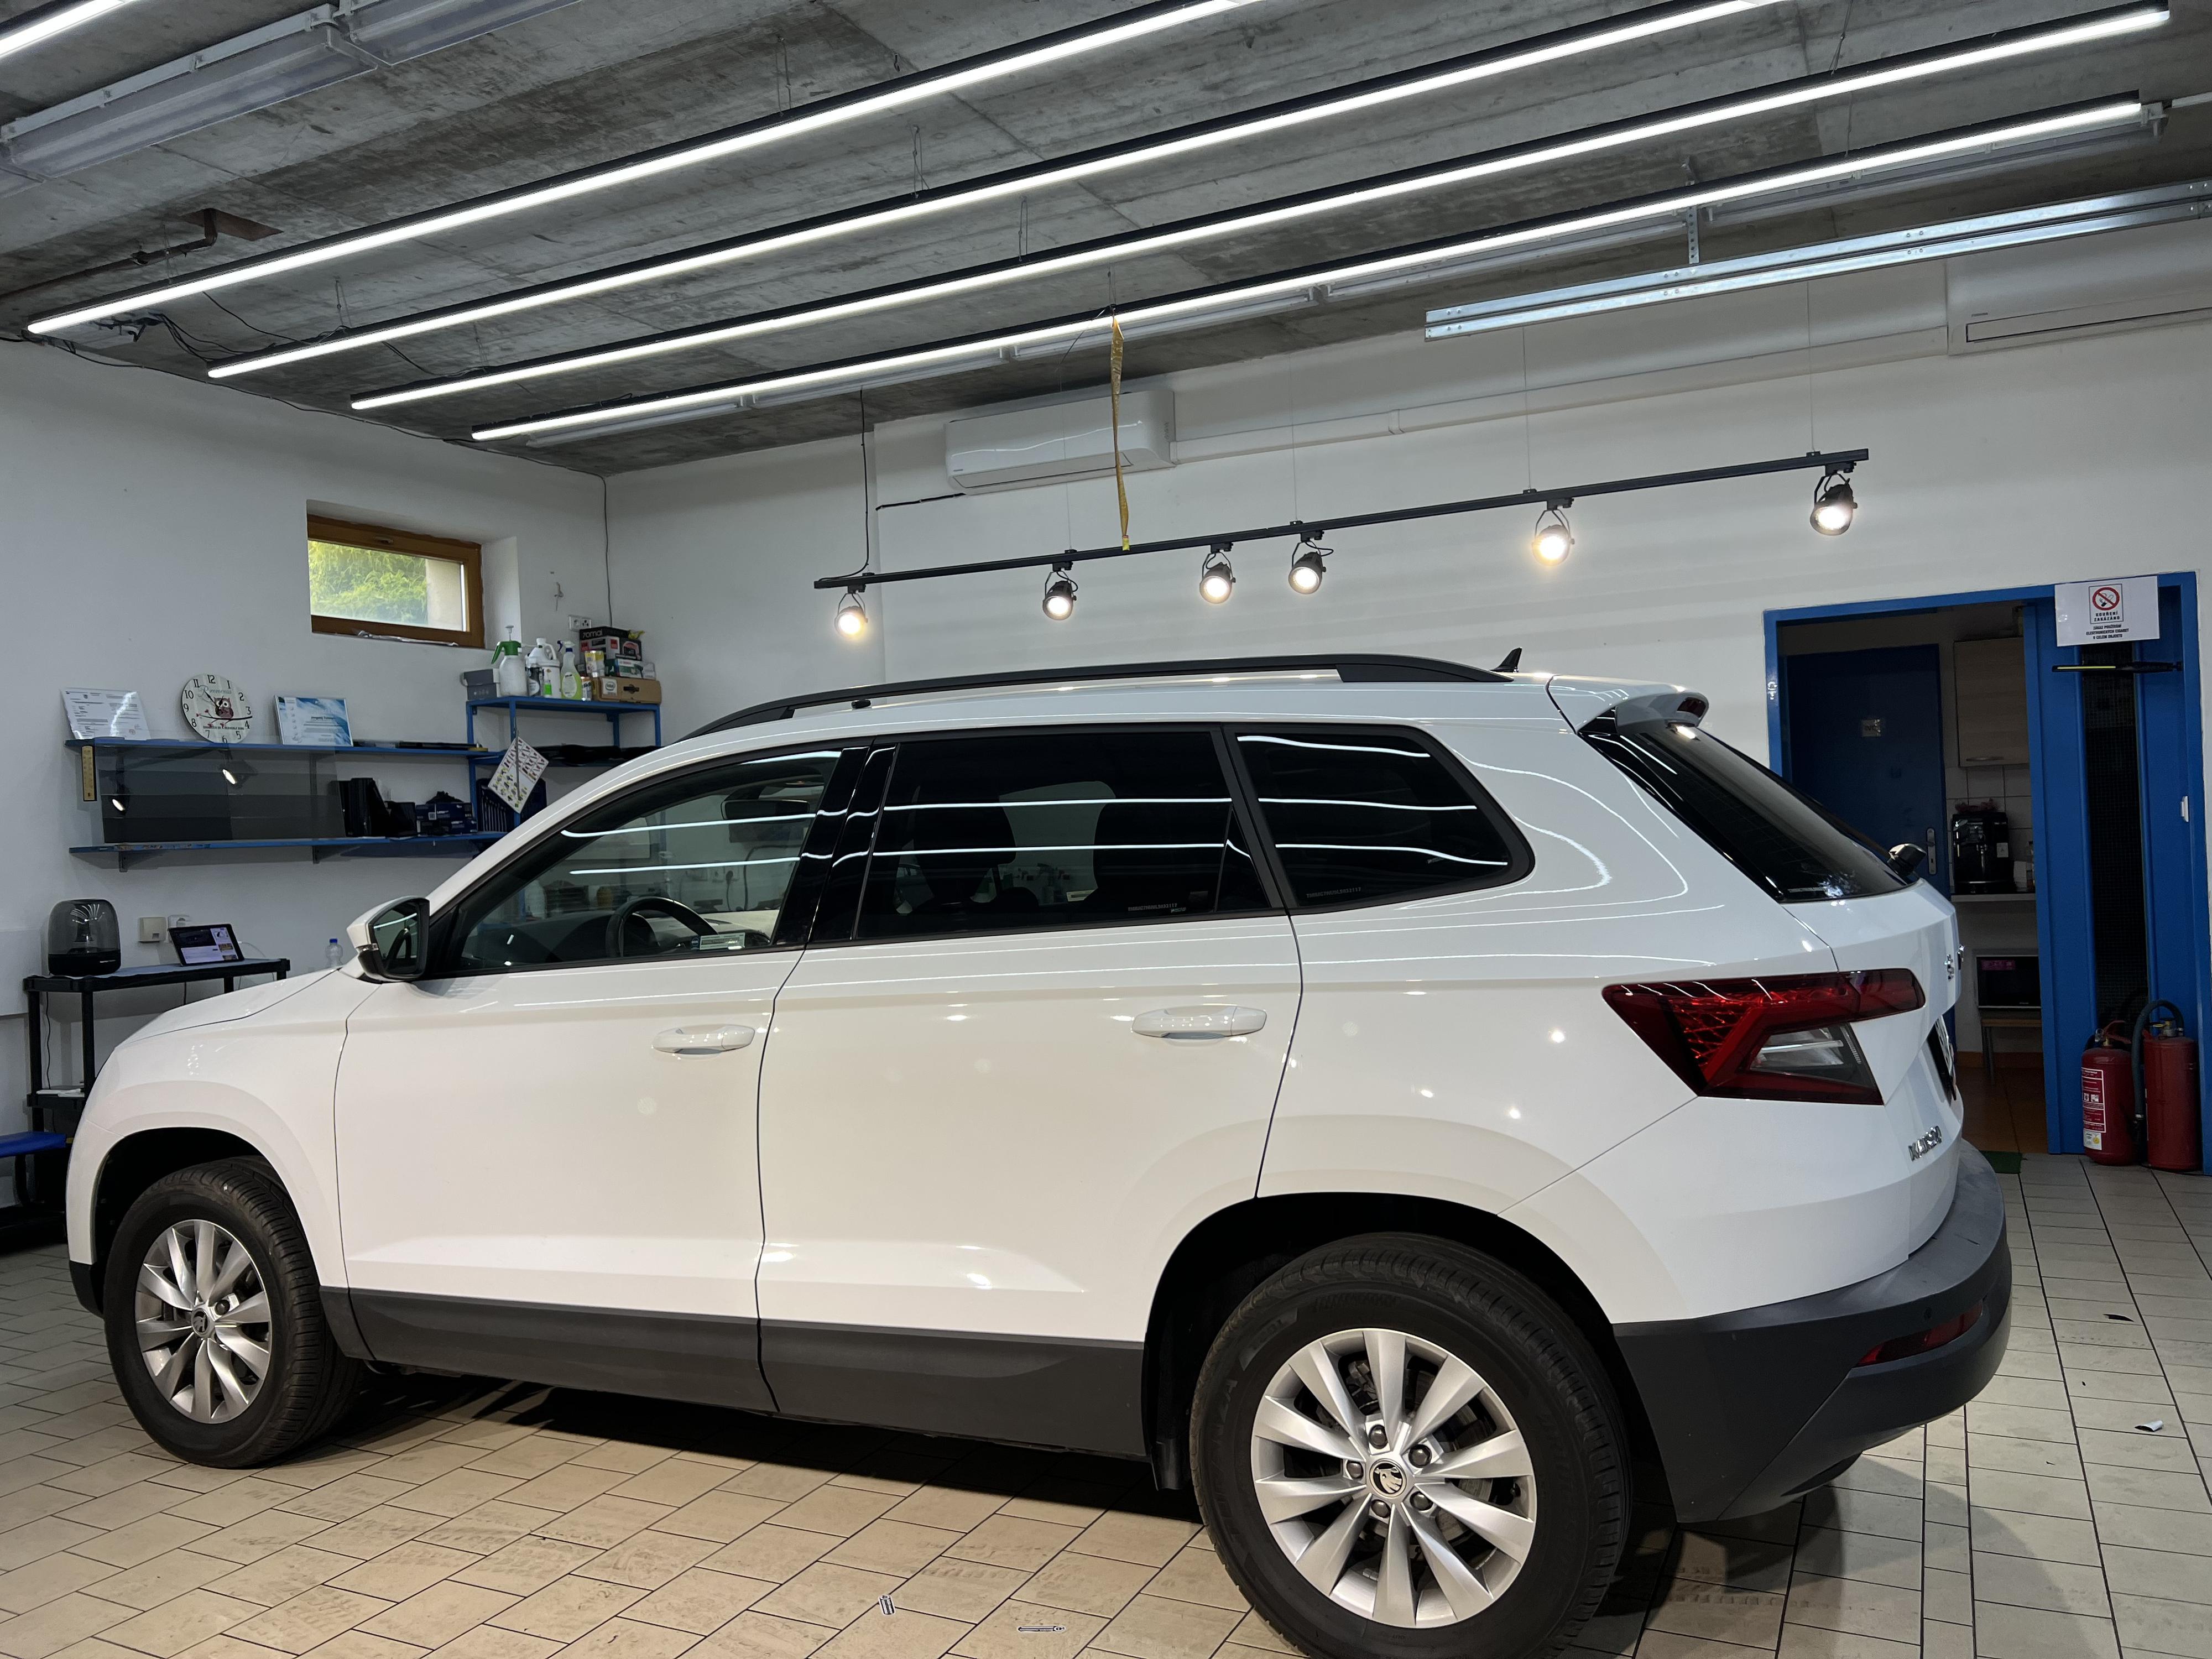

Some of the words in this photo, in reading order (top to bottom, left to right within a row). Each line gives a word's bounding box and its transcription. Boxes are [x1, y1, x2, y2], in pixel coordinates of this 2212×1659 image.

[194, 679, 200, 688] 11
[207, 674, 216, 684] 12
[227, 680, 231, 689] 1
[185, 690, 194, 699] 10
[238, 692, 244, 701] 2
[183, 703, 189, 712] 9
[246, 706, 251, 715] 3
[191, 718, 197, 727] 8
[244, 720, 250, 729] 4
[205, 729, 210, 738] 7
[236, 731, 242, 739] 5
[222, 735, 228, 743] 6
